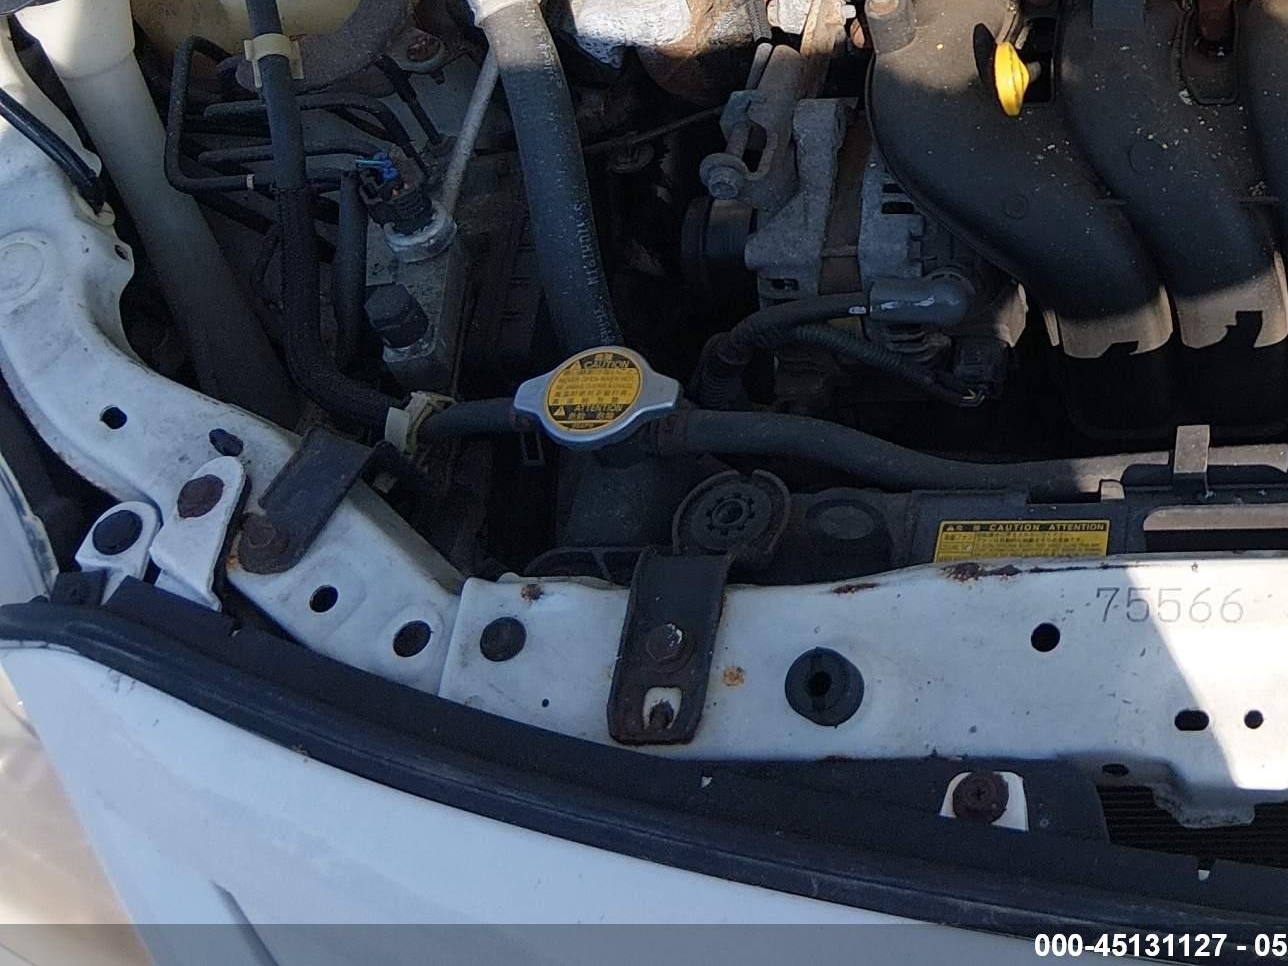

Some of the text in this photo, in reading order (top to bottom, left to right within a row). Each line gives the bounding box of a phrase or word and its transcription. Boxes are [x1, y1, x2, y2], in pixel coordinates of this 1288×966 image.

[584, 360, 629, 369] CAUTION
[574, 404, 623, 412] ATTENTION
[989, 523, 1040, 532] CAUTION
[1048, 522, 1104, 532] ATTENTION
[1096, 587, 1244, 623] 75566
